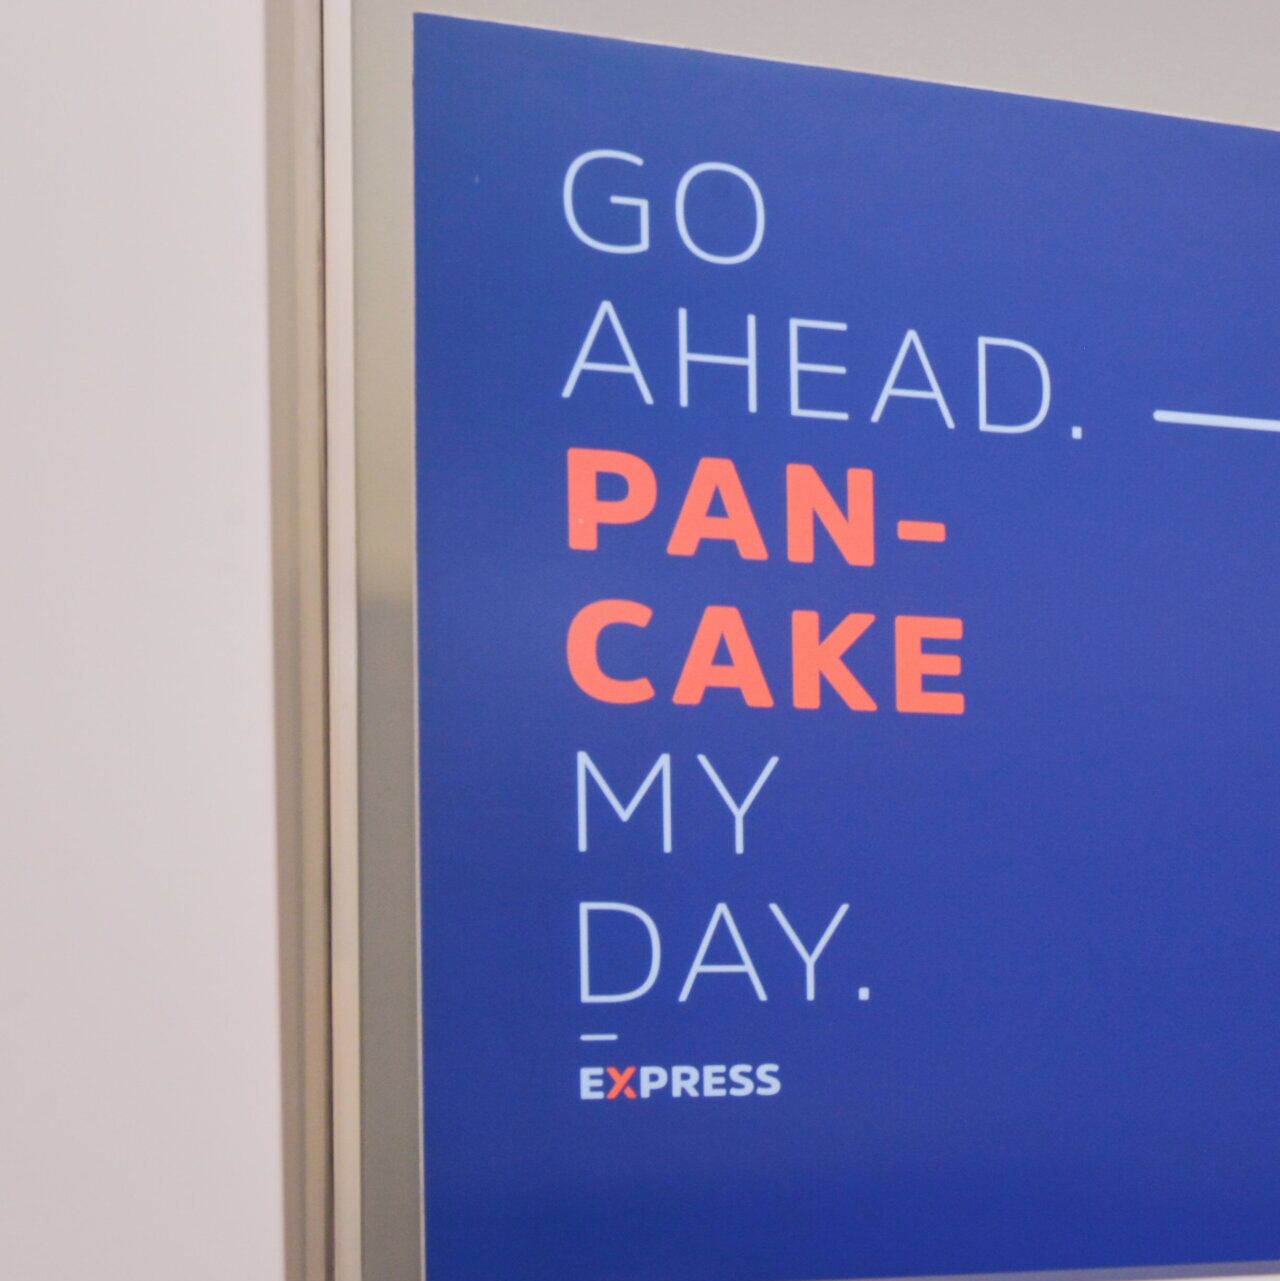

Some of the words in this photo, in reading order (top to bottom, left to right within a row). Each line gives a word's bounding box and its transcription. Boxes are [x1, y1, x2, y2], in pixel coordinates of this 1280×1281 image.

[562, 148, 766, 266] GO
[561, 300, 1084, 440] AHEAD.
[566, 446, 947, 567] PAN-
[565, 598, 966, 716] CAKE
[576, 750, 780, 855] MY
[578, 901, 871, 1004] DAY.
[578, 1062, 783, 1101] EXPRESS
